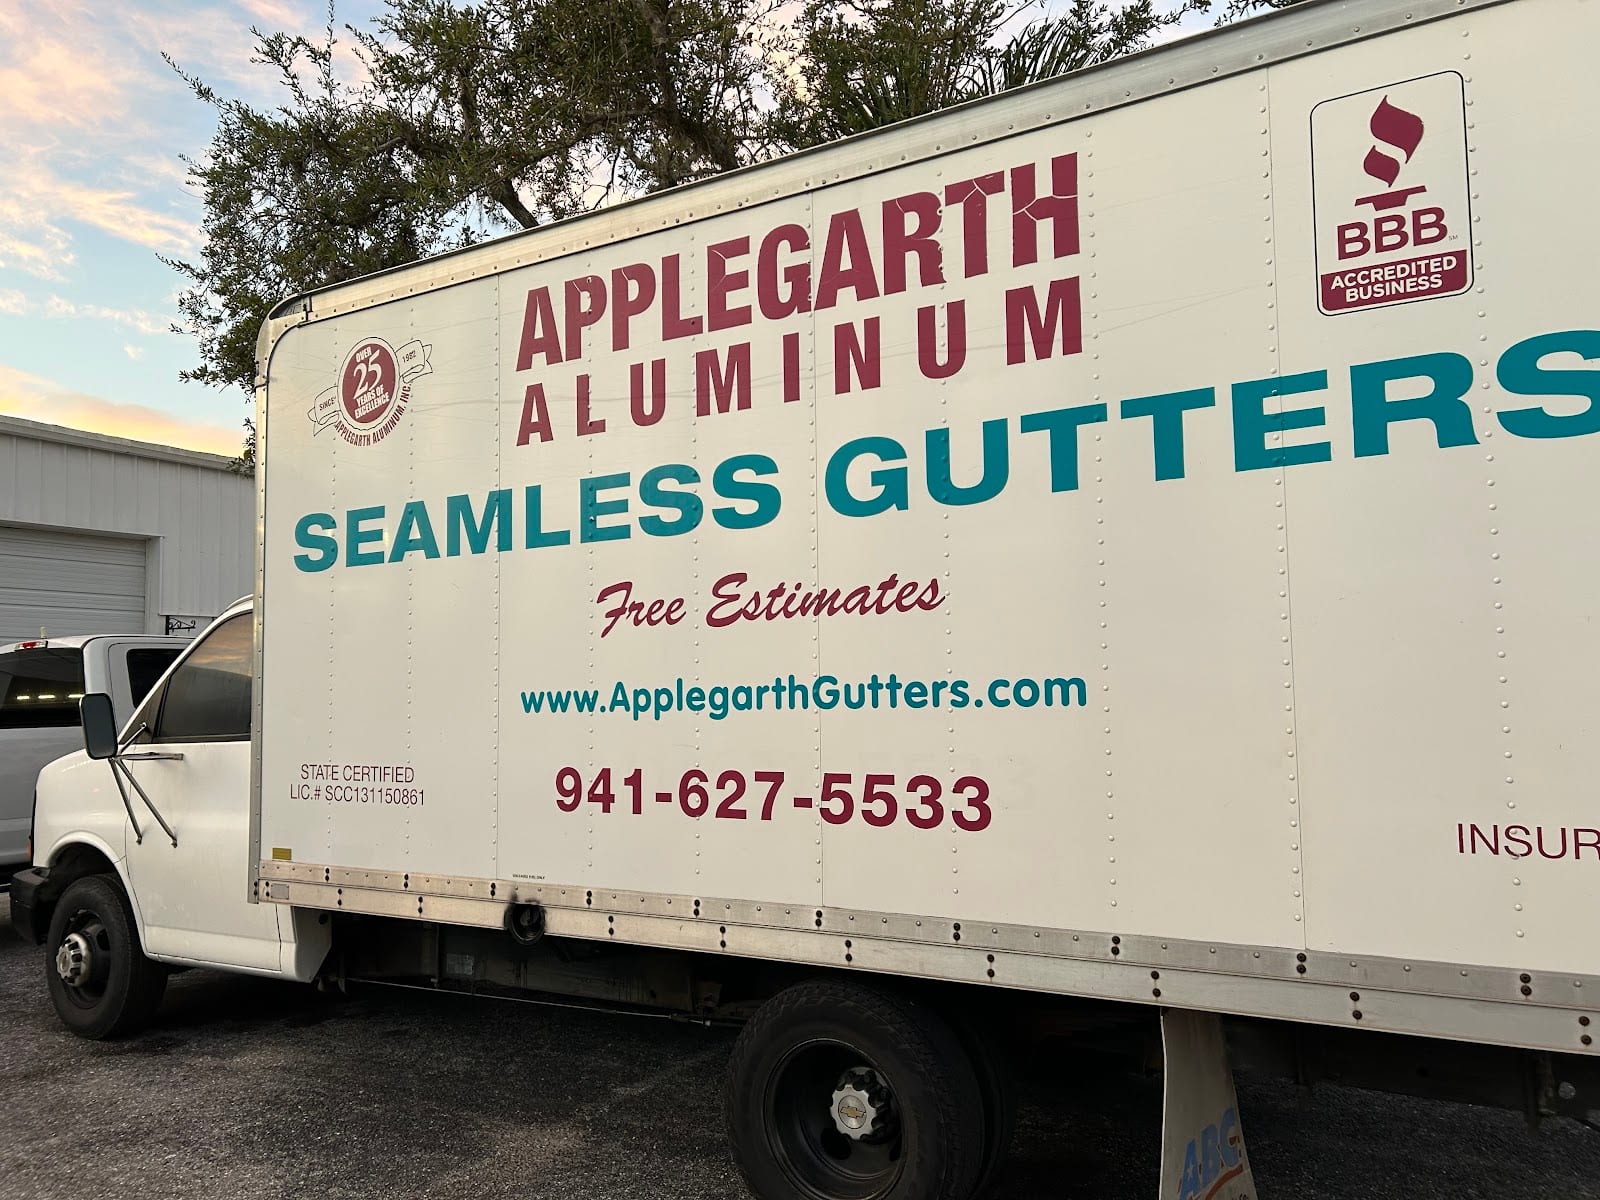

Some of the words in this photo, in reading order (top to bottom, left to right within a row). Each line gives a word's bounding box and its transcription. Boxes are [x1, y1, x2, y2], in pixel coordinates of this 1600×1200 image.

[1336, 206, 1448, 261] BBB
[516, 152, 1080, 372] APPLEGARTH
[1331, 255, 1457, 290] ACCREDITED
[1345, 274, 1443, 302] BUSINESS
[353, 349, 382, 400] 25
[355, 346, 372, 363] OVER
[516, 276, 1083, 446] ALUMINUM
[357, 387, 377, 407] YEARS
[375, 383, 385, 398] OF
[294, 454, 782, 573] SEAMLESS
[824, 330, 1600, 518] GUTTERS
[335, 420, 371, 447] APPLEGARTH
[597, 582, 686, 638] Free
[706, 573, 946, 628] Estimates
[521, 674, 1088, 721] www.ApplegarthGutters.com
[300, 764, 340, 781] STATE
[342, 766, 415, 783] CERTIFIED
[290, 784, 321, 801] LIC.#
[325, 786, 425, 806] SCC131150861
[555, 766, 992, 832] 941-627-5533
[1457, 823, 1600, 861] INSUR
